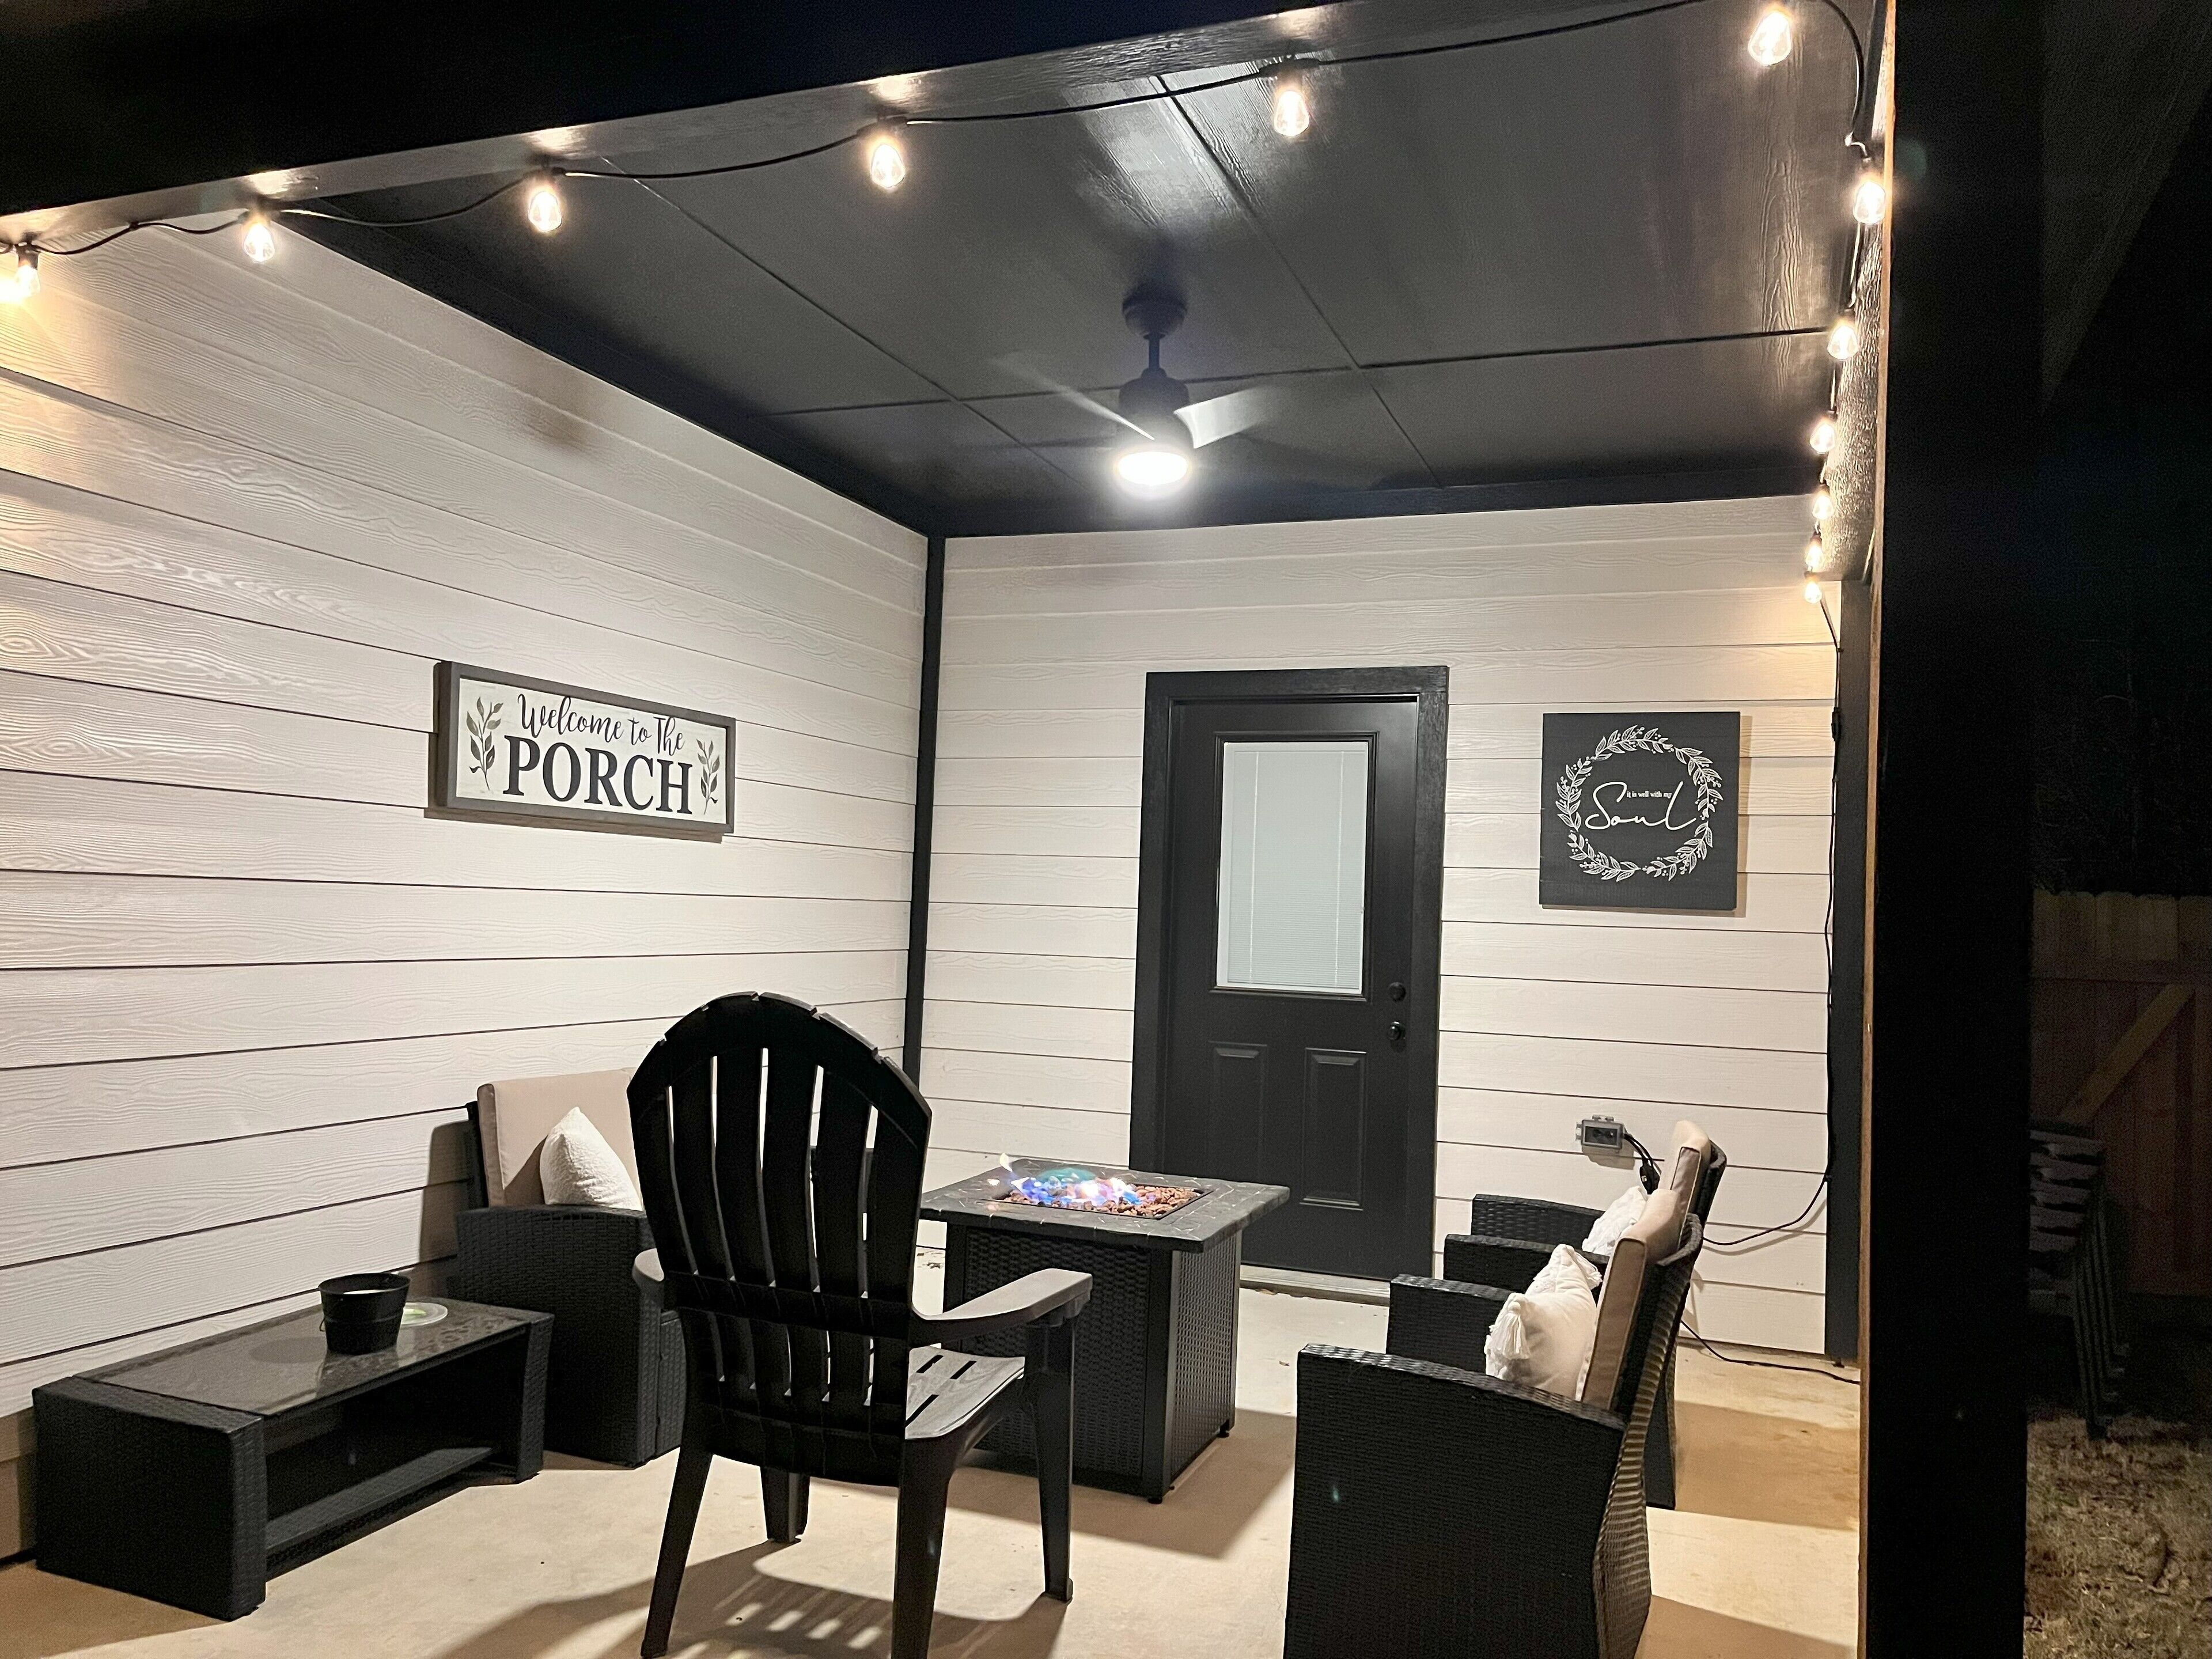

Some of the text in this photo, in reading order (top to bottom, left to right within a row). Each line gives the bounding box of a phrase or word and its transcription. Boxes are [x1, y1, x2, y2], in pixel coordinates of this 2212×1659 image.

[517, 694, 685, 756] Welcome to The
[502, 735, 693, 815] PORCH
[1585, 781, 1696, 830] Soul
